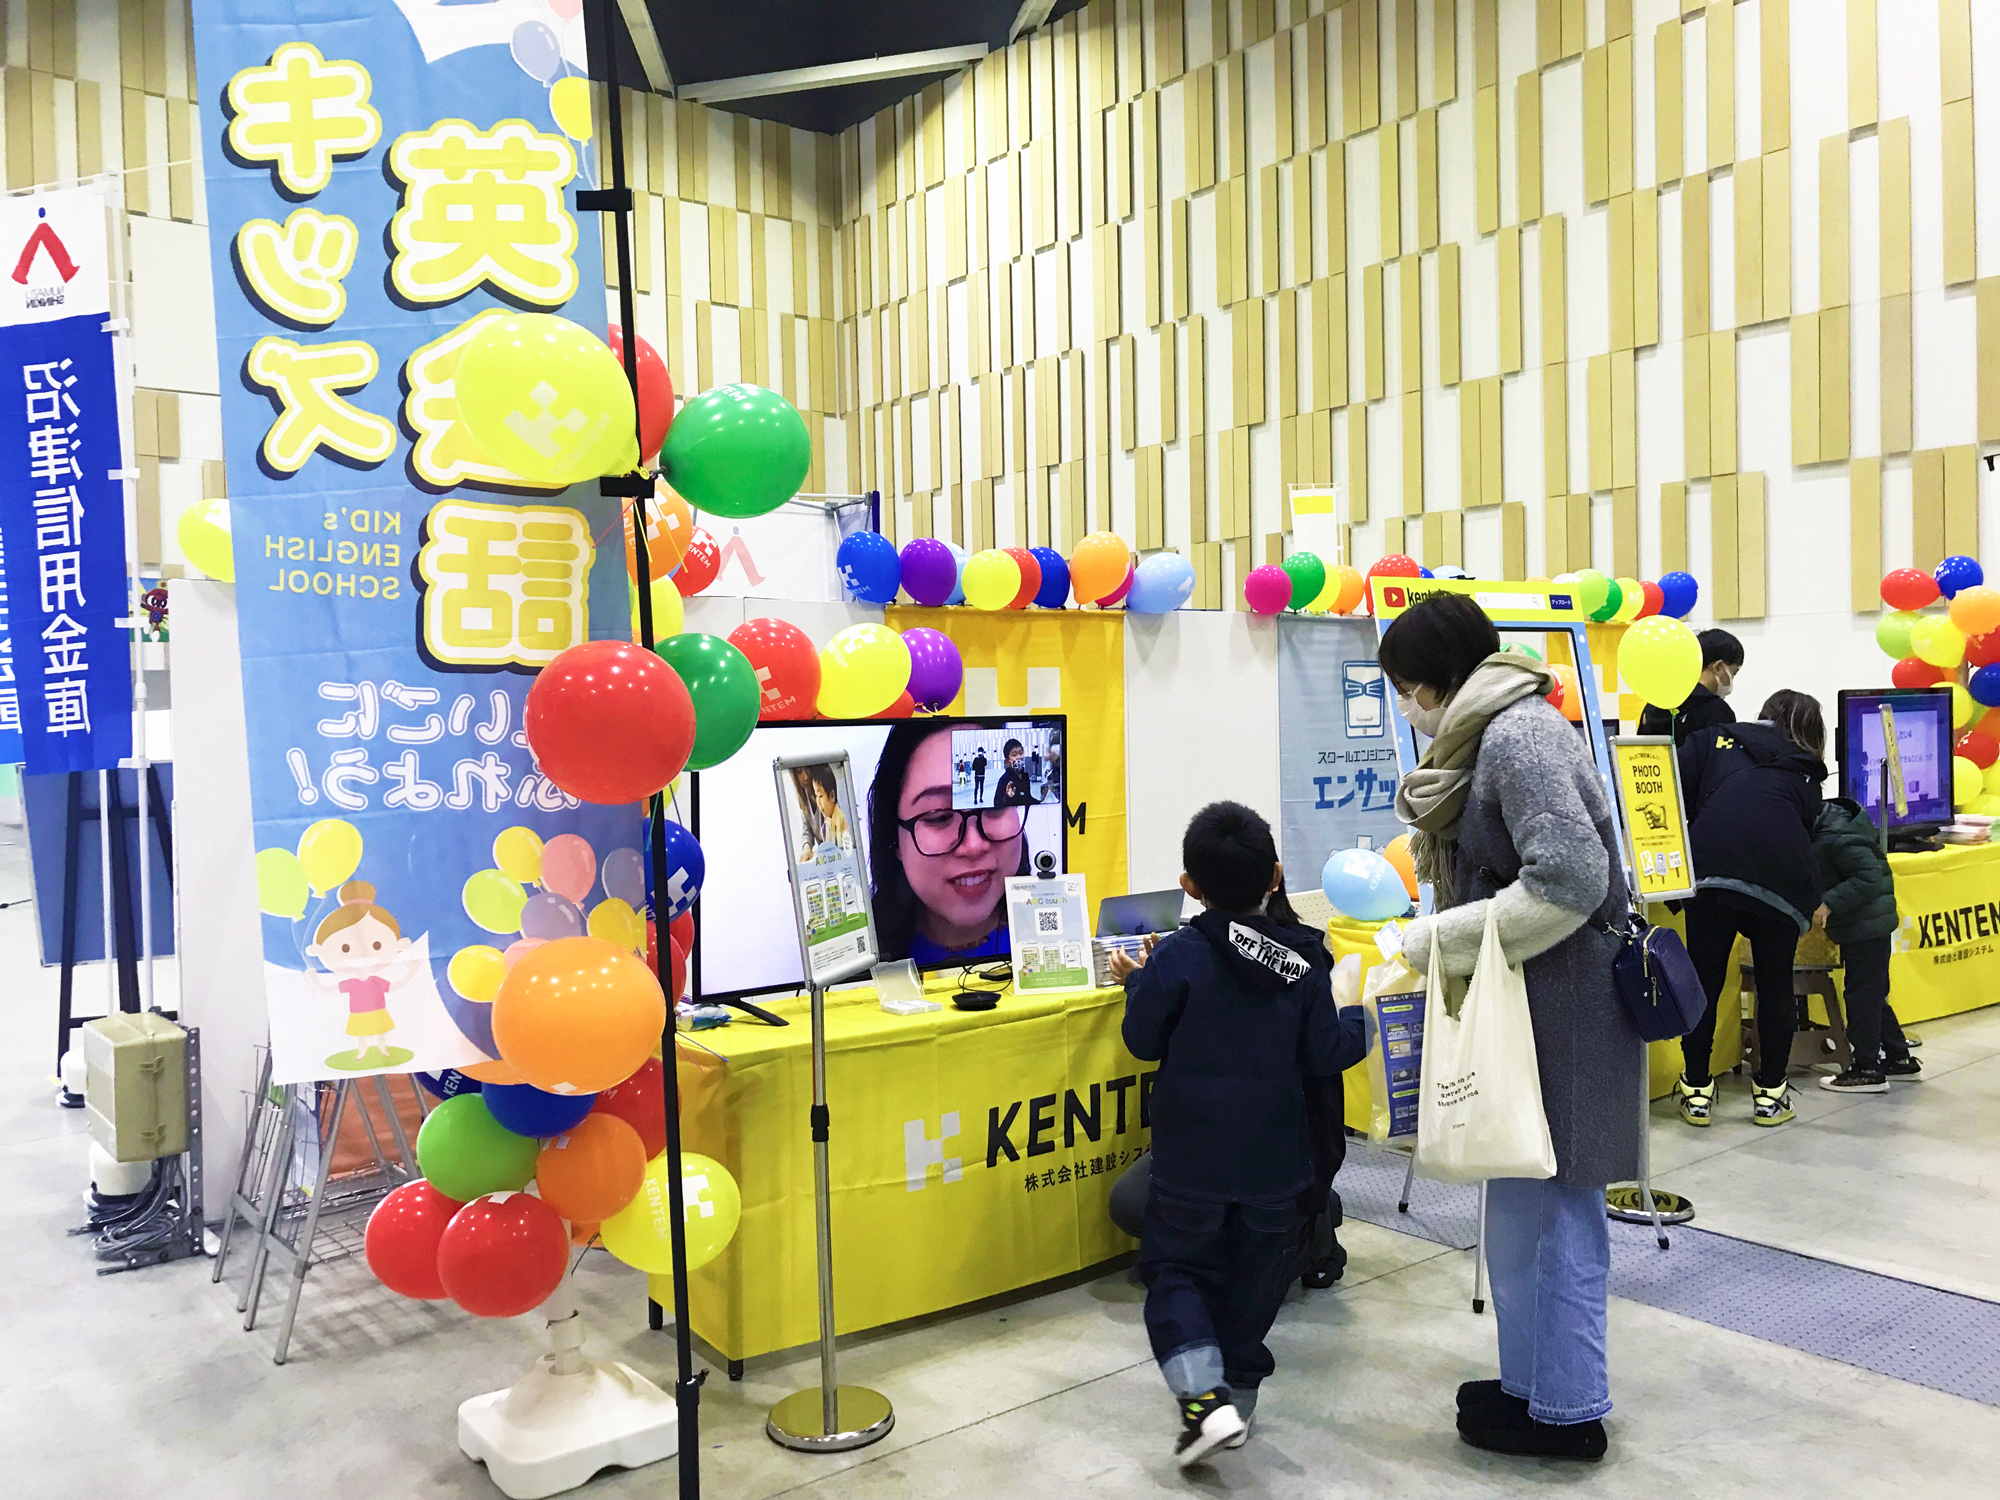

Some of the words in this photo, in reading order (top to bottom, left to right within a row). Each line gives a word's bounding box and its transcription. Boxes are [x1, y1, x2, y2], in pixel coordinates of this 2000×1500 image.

[1318, 749, 1396, 764] スクールエンジニア
[1632, 764, 1661, 778] PHOTO
[1635, 781, 1663, 794] BOOTH
[1256, 943, 1280, 971] THE
[986, 1074, 1157, 1169] KENTE
[1024, 1145, 1150, 1193] 株式会社建設シス
[645, 1178, 669, 1241] KENTEM
